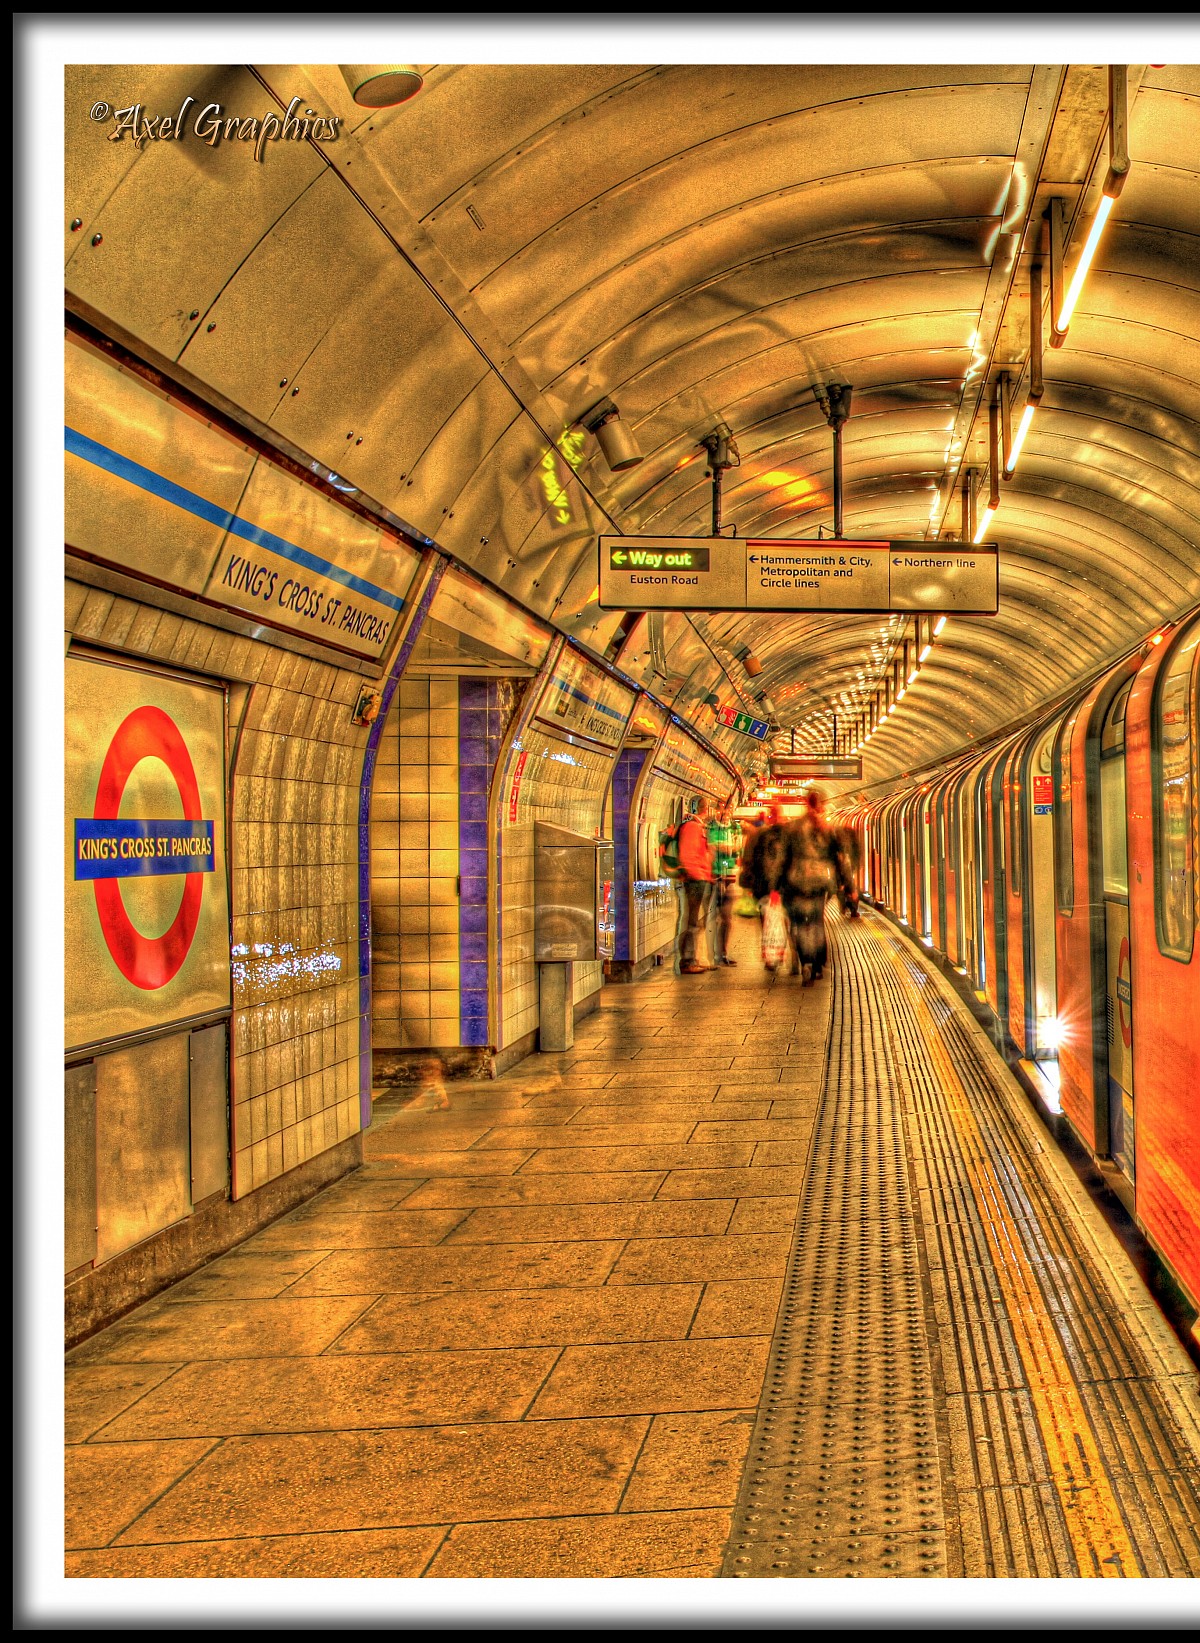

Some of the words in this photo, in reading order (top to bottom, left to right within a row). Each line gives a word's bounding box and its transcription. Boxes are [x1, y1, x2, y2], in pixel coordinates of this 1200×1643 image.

[629, 551, 662, 568] Way
[665, 553, 692, 566] out
[760, 555, 836, 566] Hammersmith
[838, 556, 847, 565] &
[904, 558, 953, 567] Northern
[956, 559, 976, 568] line
[760, 566, 830, 578] Metropolitan
[833, 568, 853, 577] and
[630, 575, 668, 584] Euston
[671, 575, 698, 585] Road
[760, 578, 792, 588] Circle
[794, 579, 820, 588] lines
[222, 554, 278, 601] KING'S
[278, 579, 324, 619] CROSS
[321, 598, 341, 626] ST.
[338, 605, 390, 645] PANCRAS
[78, 838, 118, 860] KING'S
[119, 837, 155, 859] CROSS
[156, 837, 170, 857] ST.
[171, 837, 212, 857] PANCRAS
